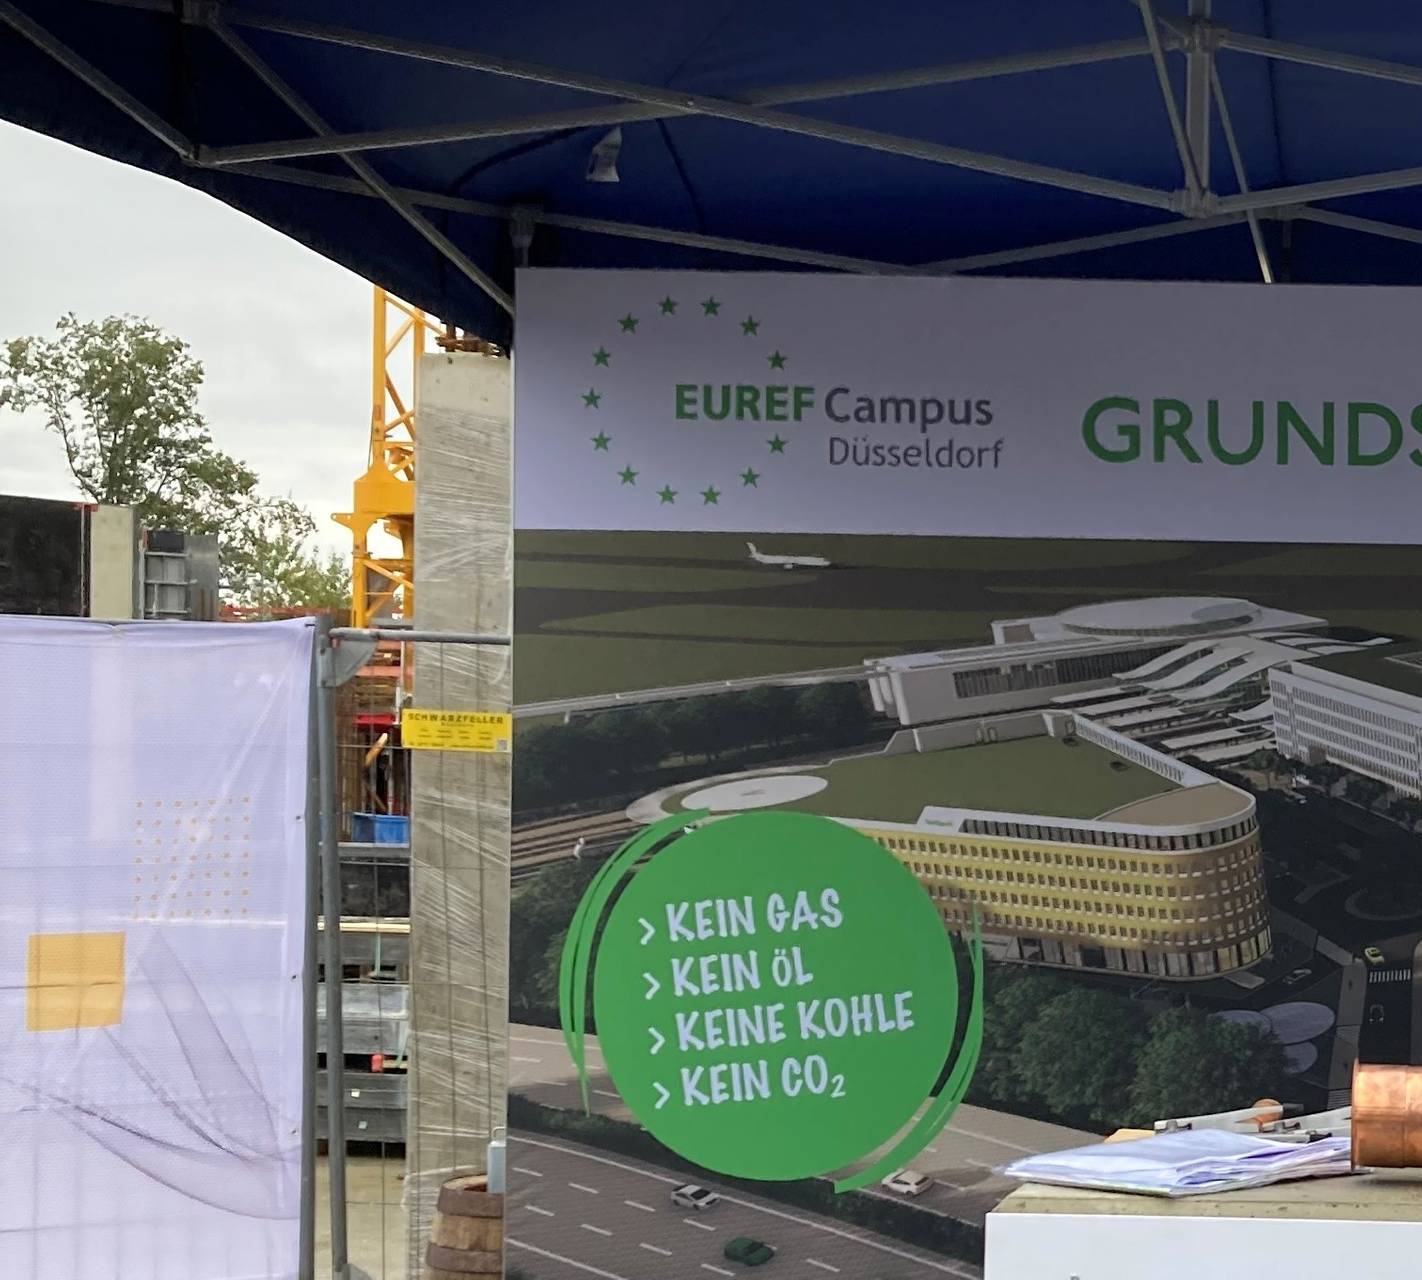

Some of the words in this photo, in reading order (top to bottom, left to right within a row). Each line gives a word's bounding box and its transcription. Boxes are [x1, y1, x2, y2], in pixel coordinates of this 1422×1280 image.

[675, 384, 815, 422] EUREF
[824, 387, 994, 433] Campus
[828, 435, 1004, 469] Düsseldorf
[665, 896, 756, 942] KEIN
[767, 888, 843, 933] GAS
[671, 950, 761, 997] KEIN
[771, 946, 814, 988] ÖL
[675, 1003, 788, 1051] KEINE
[797, 991, 915, 1041] KOHLE
[681, 1059, 771, 1106] KEIN
